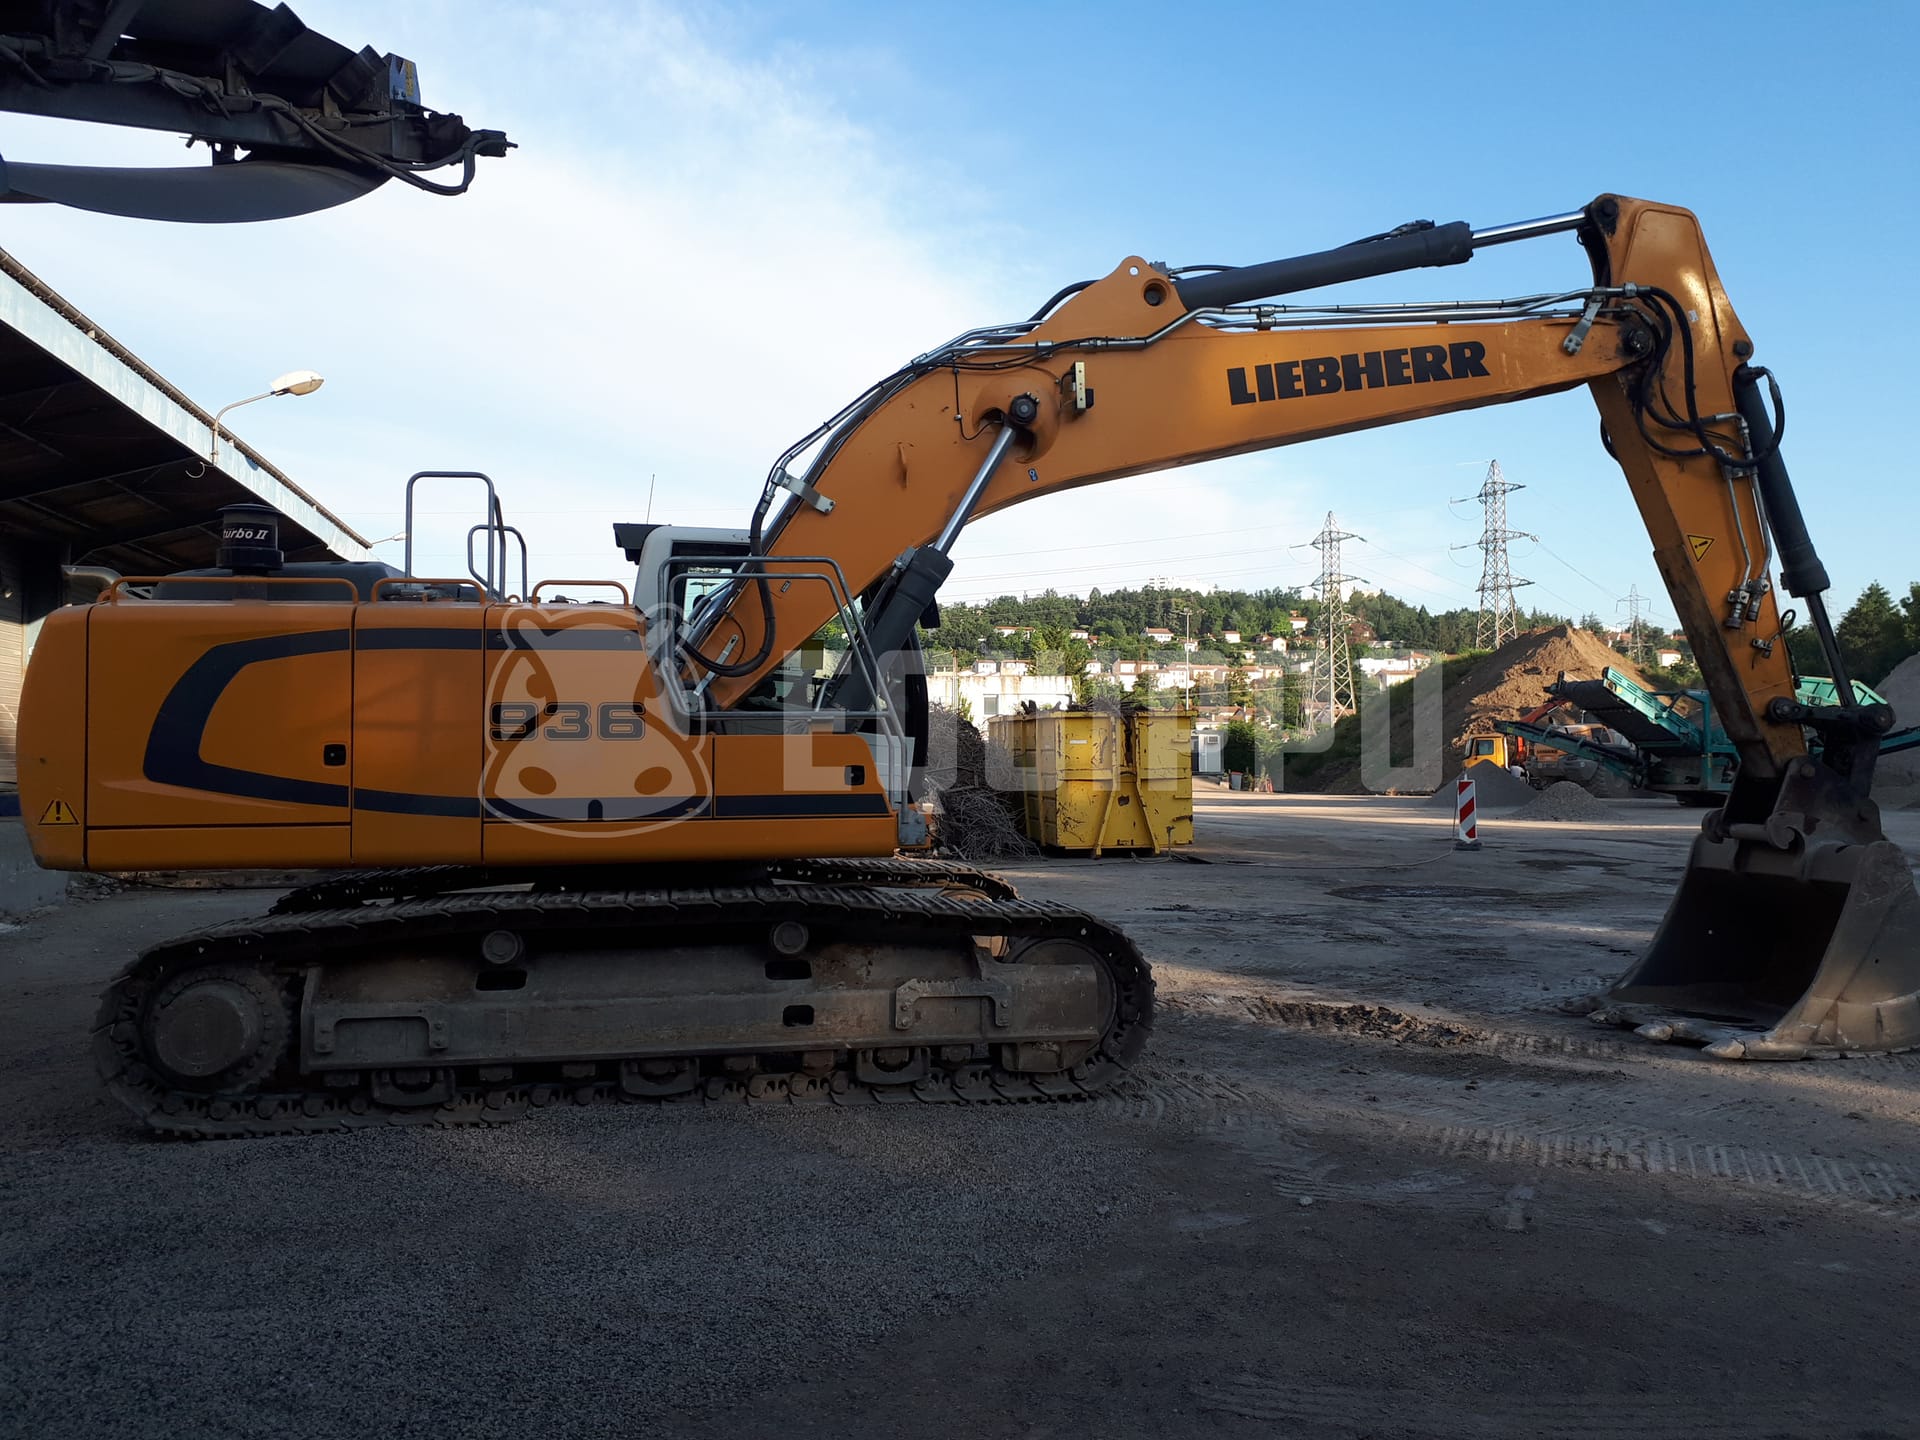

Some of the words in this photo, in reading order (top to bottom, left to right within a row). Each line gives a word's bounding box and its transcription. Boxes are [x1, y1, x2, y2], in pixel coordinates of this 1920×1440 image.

[1227, 341, 1490, 405] LIEBHERR
[254, 529, 268, 540] II
[490, 702, 645, 741] 936
